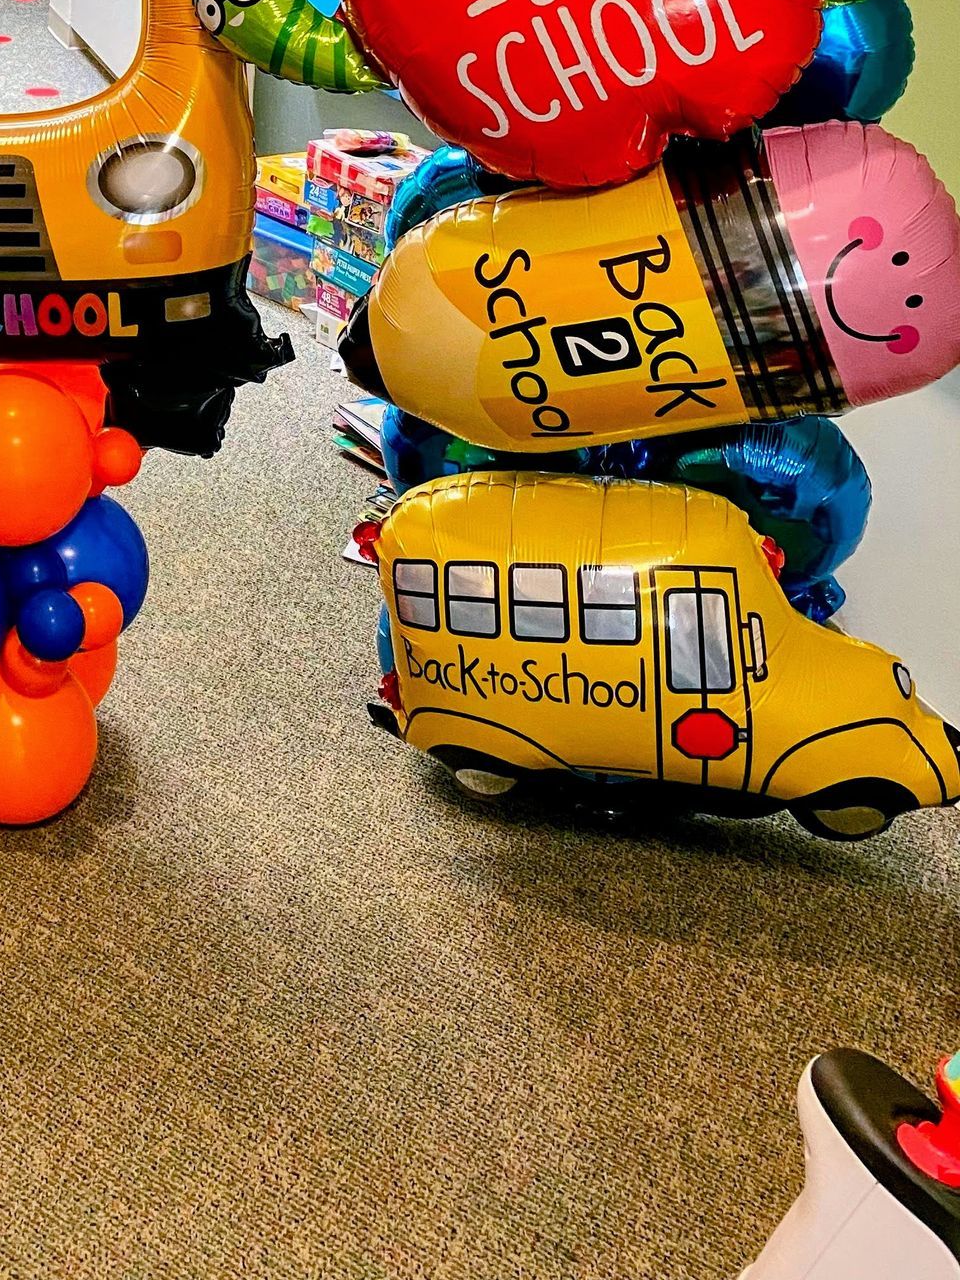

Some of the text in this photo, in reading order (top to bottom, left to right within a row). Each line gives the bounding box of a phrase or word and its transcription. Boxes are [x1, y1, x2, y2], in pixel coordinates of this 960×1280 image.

[474, 248, 594, 438] School
[565, 331, 631, 367] 2
[598, 234, 728, 418] Back
[400, 634, 647, 713] Back-to-School
